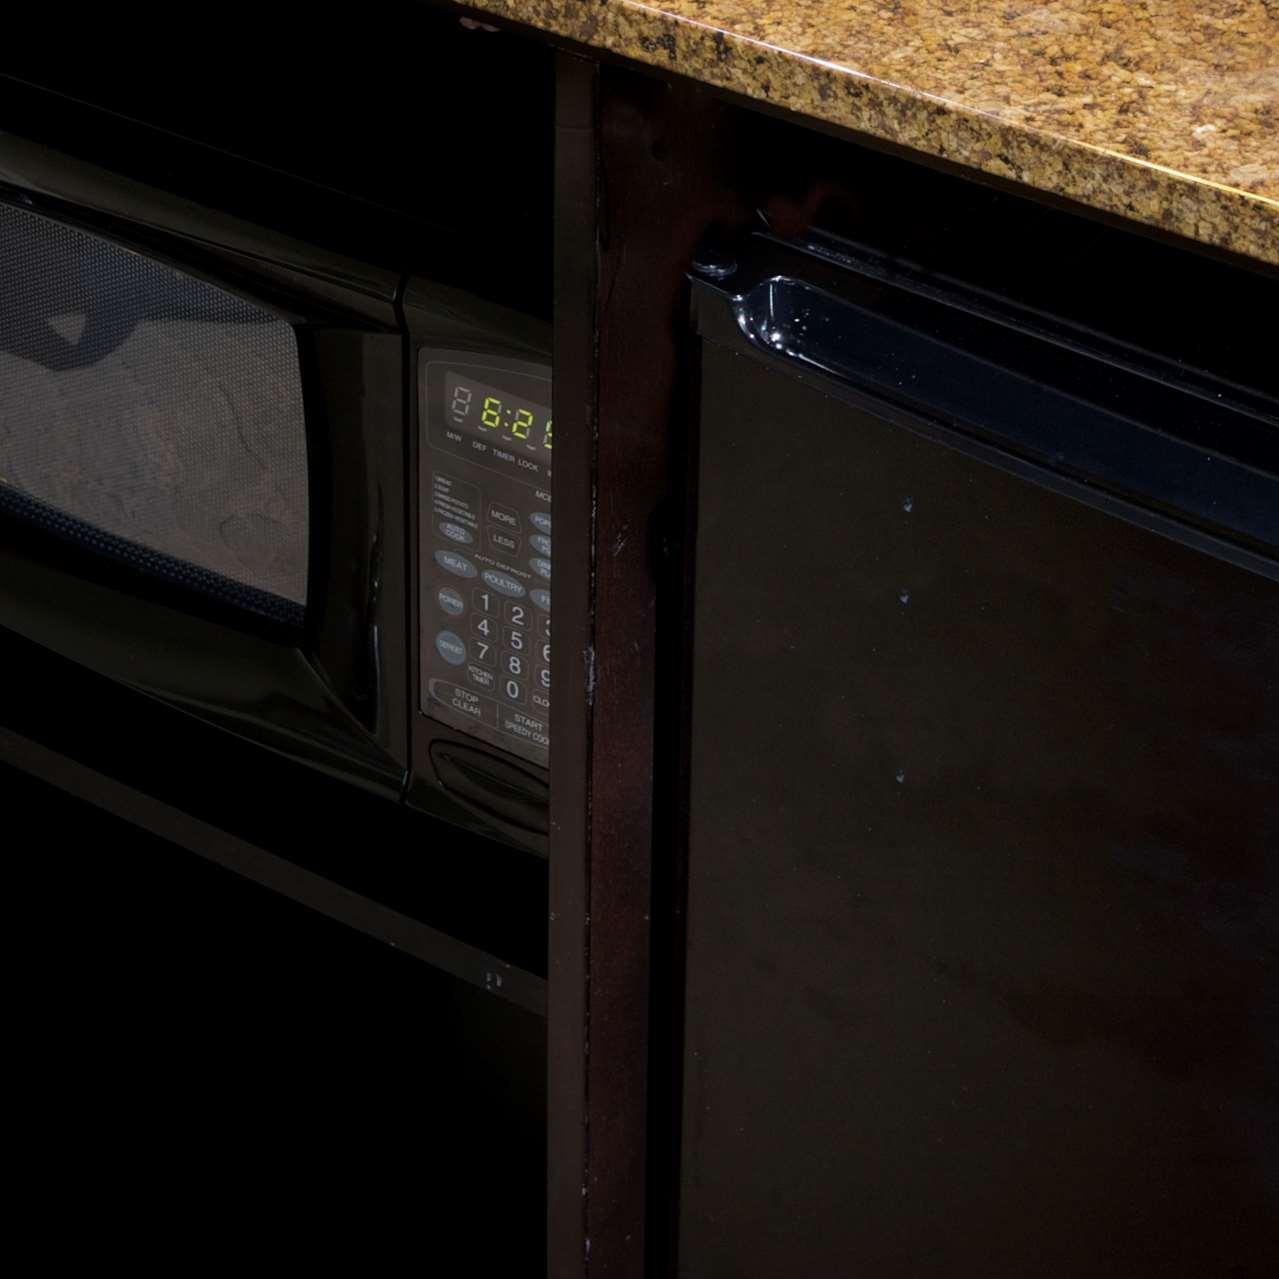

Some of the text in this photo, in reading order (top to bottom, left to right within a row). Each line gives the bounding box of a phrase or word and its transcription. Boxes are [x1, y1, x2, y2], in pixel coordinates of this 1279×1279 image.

[518, 458, 539, 472] LOCK
[483, 572, 524, 594] POULTRY
[480, 593, 489, 611] 1
[511, 606, 525, 626] 2
[477, 619, 490, 637] 4
[511, 631, 523, 650] 5
[477, 642, 489, 659] 7
[509, 656, 521, 674] 8
[454, 687, 479, 703] STOP
[506, 680, 519, 699] 0
[452, 697, 481, 716] CLEAR
[514, 713, 545, 731] START
